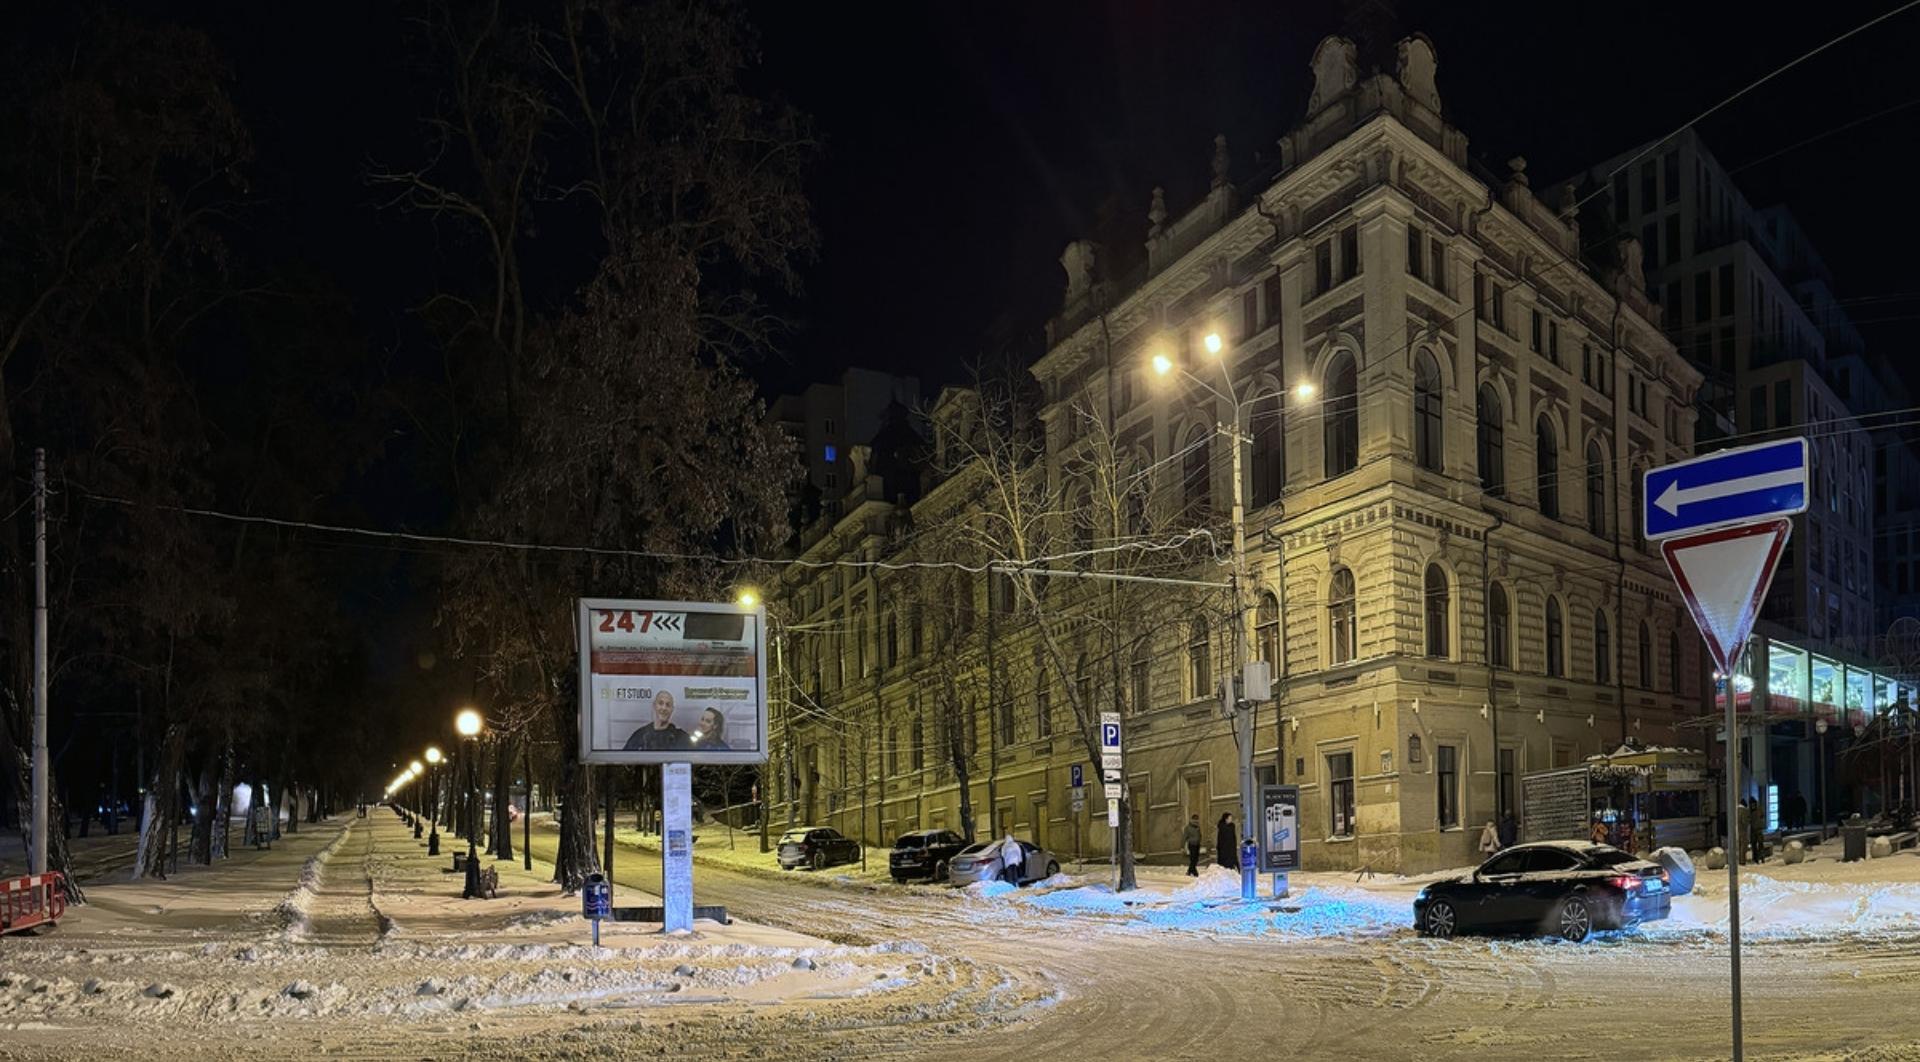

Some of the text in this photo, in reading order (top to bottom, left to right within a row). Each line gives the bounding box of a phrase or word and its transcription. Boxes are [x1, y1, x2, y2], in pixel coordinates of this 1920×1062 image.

[599, 610, 653, 633] 247
[627, 688, 652, 699] STUDIO
[1107, 726, 1117, 745] P
[1073, 766, 1081, 785] P
